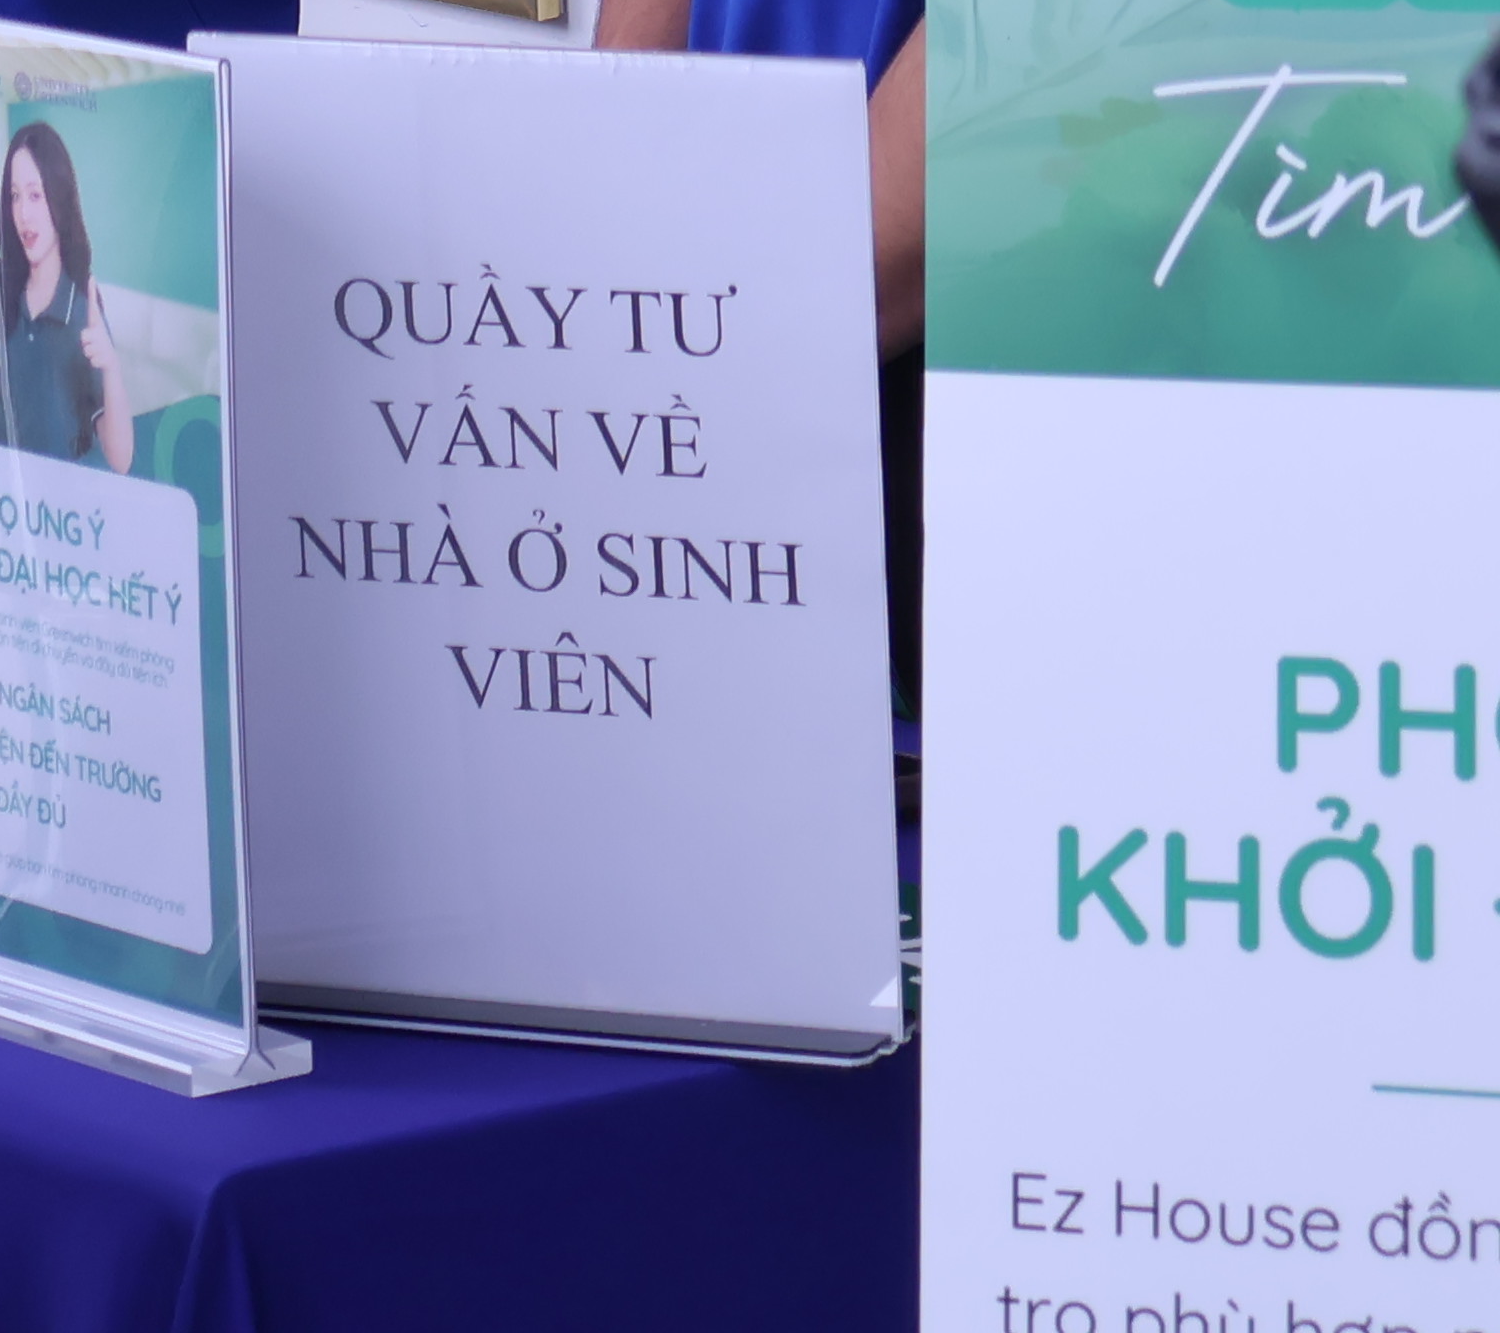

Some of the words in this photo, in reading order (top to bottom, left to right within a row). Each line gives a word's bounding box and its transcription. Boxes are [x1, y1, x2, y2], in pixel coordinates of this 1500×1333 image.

[1154, 64, 1472, 288] Tìm
[333, 263, 589, 360] QUẦY
[609, 283, 738, 358] TƯ
[370, 383, 563, 472] VẤN
[587, 394, 708, 479] VỀ
[25, 500, 82, 547] ƯNG
[88, 508, 106, 550] Ý
[288, 503, 483, 588] NHÀ
[507, 508, 569, 593] Ở
[597, 532, 807, 607] SINH
[44, 559, 101, 609] HỌC
[108, 570, 158, 621] HẾT
[163, 583, 183, 626] Ý
[59, 695, 112, 735] SÁCH
[445, 631, 657, 720] VIÊN
[1276, 656, 1500, 782] PH
[29, 739, 70, 776] ĐẾN
[75, 754, 163, 803] TRƯỜNG
[37, 794, 67, 829] ĐỦ
[1057, 795, 1435, 963] KHỞI
[1010, 1171, 1085, 1234] Ez
[1114, 1179, 1340, 1253] House
[1368, 1190, 1500, 1263] đồn
